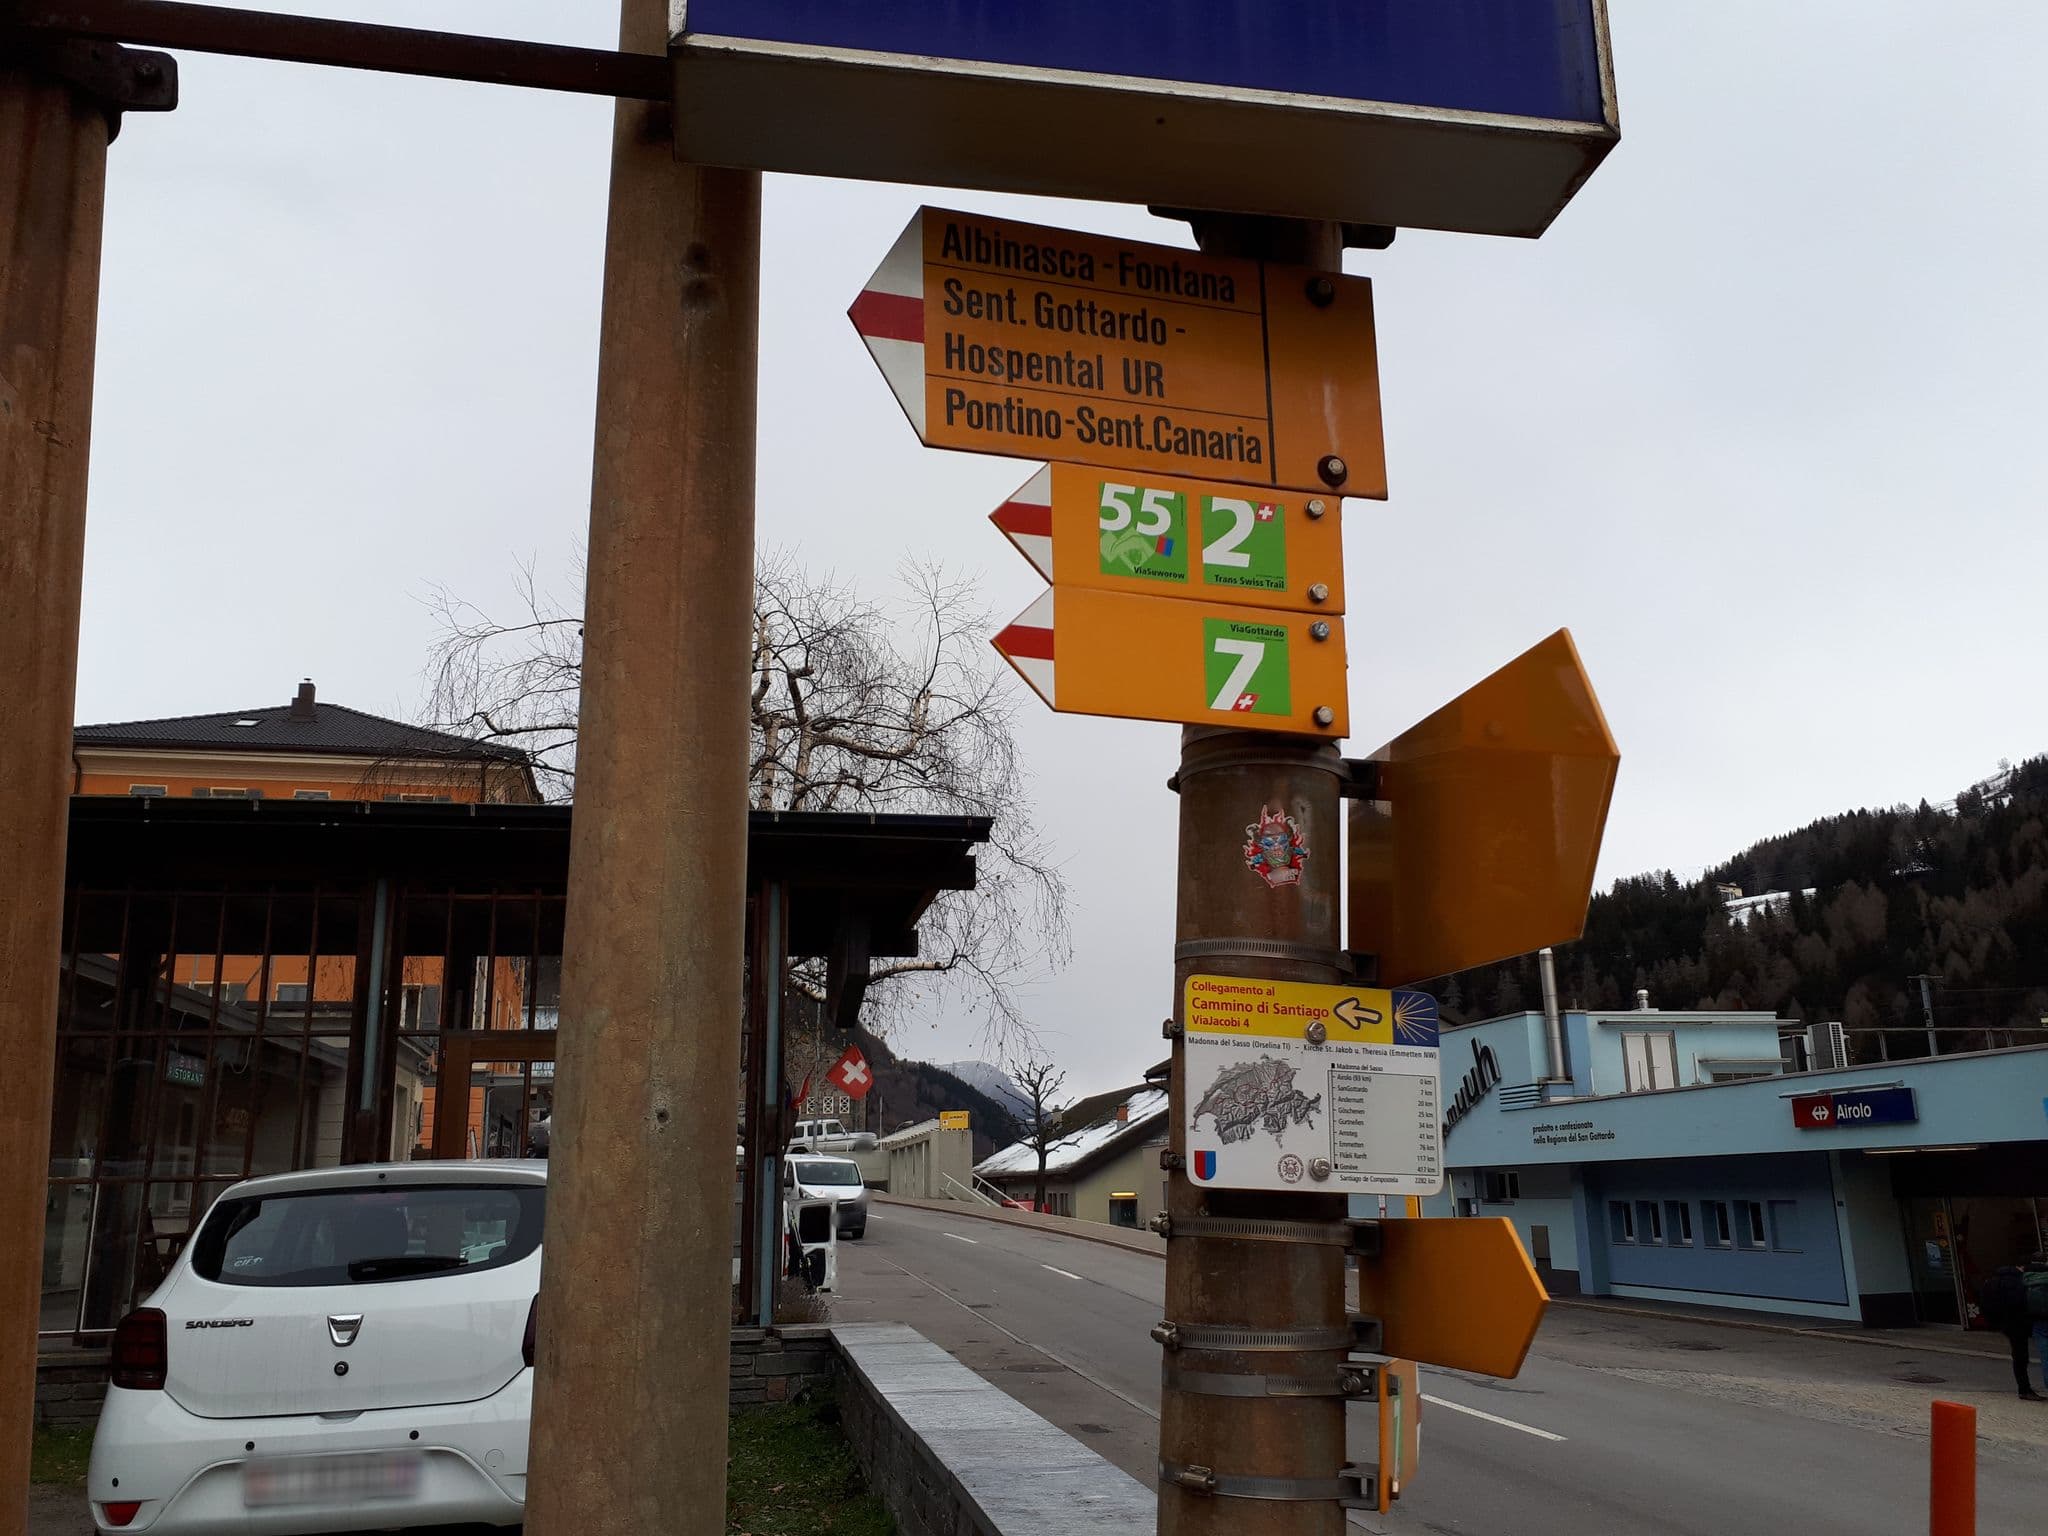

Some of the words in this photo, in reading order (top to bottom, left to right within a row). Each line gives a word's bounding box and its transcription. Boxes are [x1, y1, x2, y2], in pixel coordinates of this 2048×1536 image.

[942, 223, 1095, 282] Albinasca
[1118, 251, 1235, 305] Fontana
[943, 278, 1027, 327] Sent.
[1034, 291, 1167, 346] Gottardo
[945, 332, 1104, 391] Hospental
[1123, 357, 1165, 398] UR
[1099, 482, 1176, 537] 55
[1202, 496, 1255, 568] 2
[1134, 566, 1185, 580] ViaSuworow
[1214, 574, 1238, 585] Trans
[1239, 576, 1264, 587] Swiss
[1266, 579, 1285, 589] Trail
[1230, 624, 1285, 638] ViaGottardo
[1210, 638, 1265, 711] 7
[1191, 981, 1264, 996] Collegamento
[1266, 986, 1275, 996] al
[1191, 997, 1253, 1013] Cammino
[1256, 1002, 1269, 1014] di
[1273, 1003, 1330, 1020] Santiago
[1192, 1015, 1241, 1028] ViaJacobi
[1243, 1018, 1250, 1028] 4
[1188, 1036, 1219, 1046] Madonna
[1220, 1038, 1231, 1047] del
[1232, 1039, 1251, 1048] Sasso
[1252, 1040, 1281, 1050] (Orselina
[1303, 1044, 1323, 1052] Kirche
[1325, 1045, 1333, 1053] St.
[1335, 1046, 1353, 1054] Jakob
[1362, 1047, 1388, 1056] Theresia
[1389, 1048, 1423, 1058] (Emmetten
[1423, 1051, 1437, 1060] NW)
[1837, 1103, 1872, 1120] Airolo
[1560, 1121, 1593, 1131] confezionato
[1569, 1133, 1577, 1142] del
[1578, 1132, 1588, 1141] San
[1590, 1129, 1616, 1140] Gottardo
[185, 1319, 253, 1329] SANDERO
